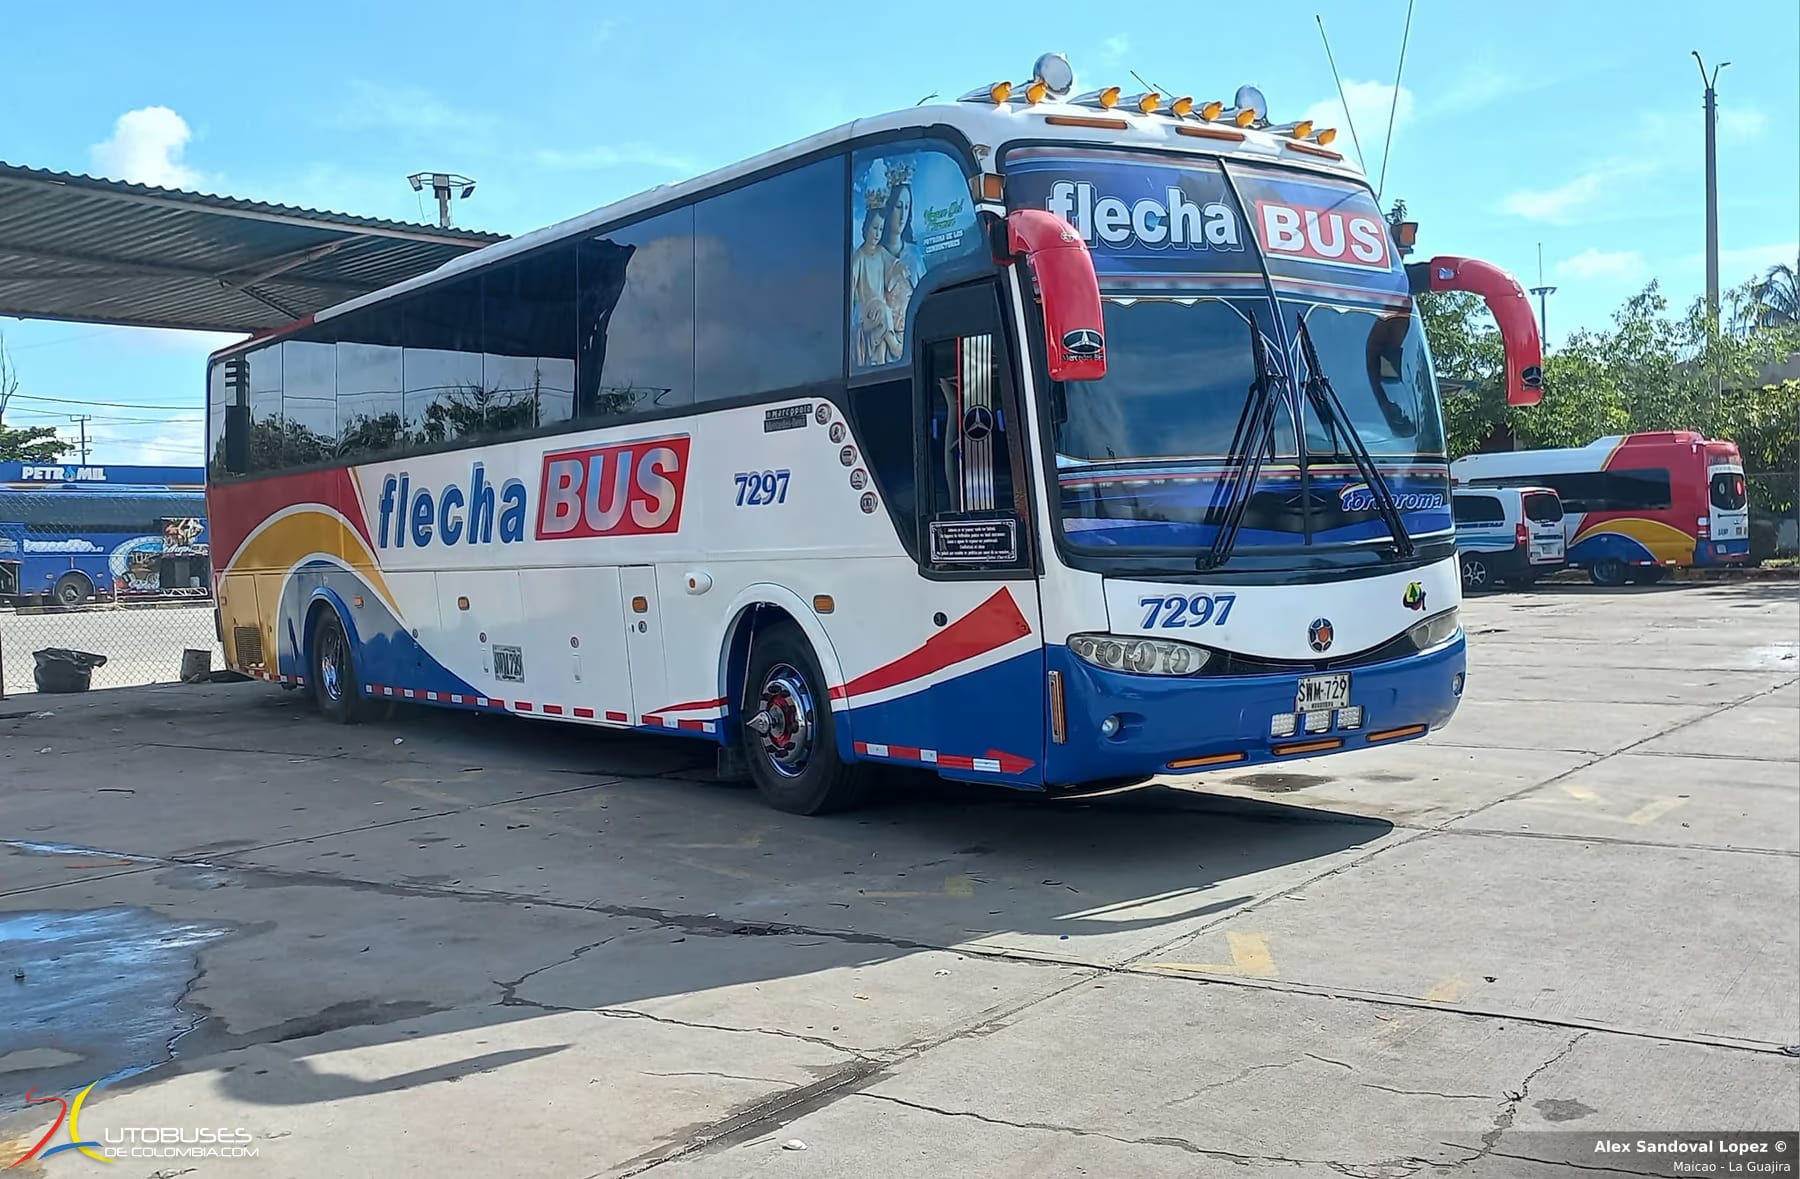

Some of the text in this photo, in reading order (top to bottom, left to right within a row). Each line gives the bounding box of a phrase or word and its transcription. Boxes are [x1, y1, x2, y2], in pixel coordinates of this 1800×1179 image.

[1048, 181, 1383, 264] flecha BUS
[378, 447, 680, 549] flecha BUS
[734, 469, 791, 506] 7297
[1138, 592, 1236, 629] 7297
